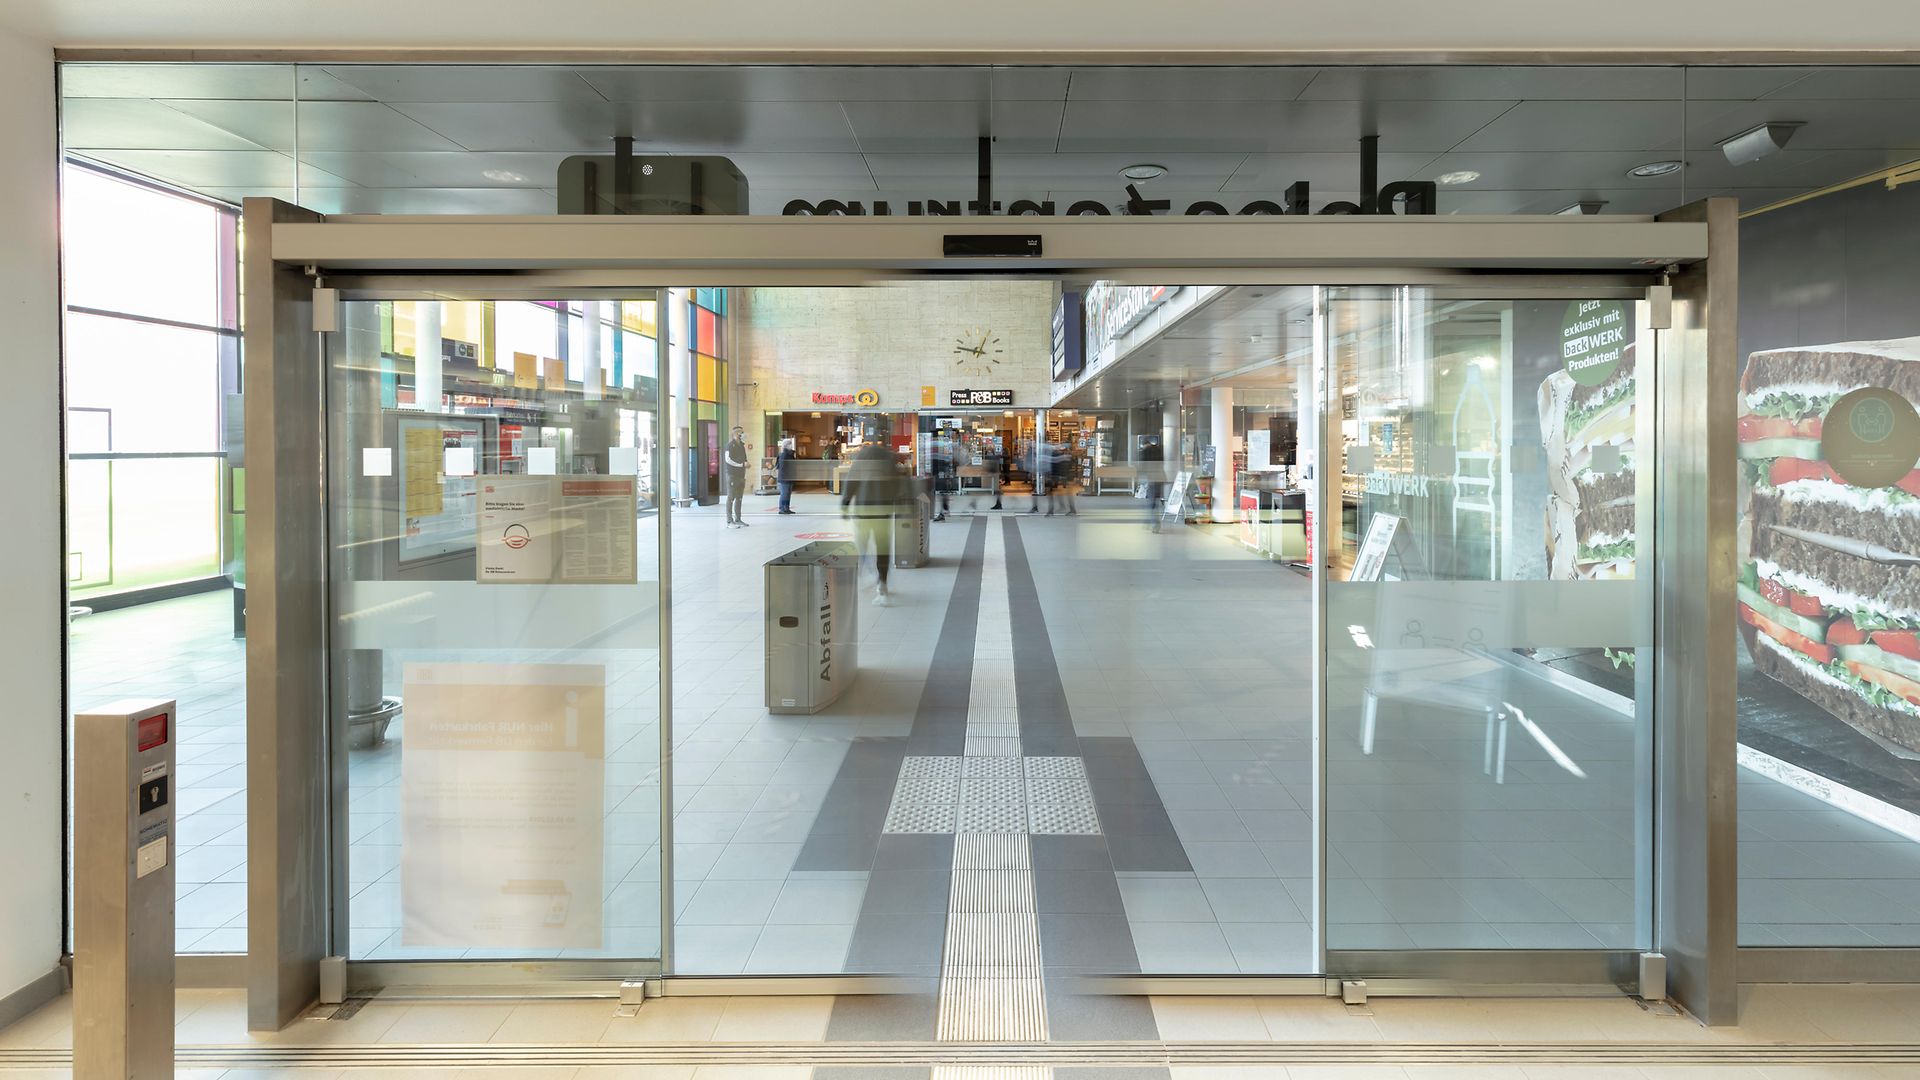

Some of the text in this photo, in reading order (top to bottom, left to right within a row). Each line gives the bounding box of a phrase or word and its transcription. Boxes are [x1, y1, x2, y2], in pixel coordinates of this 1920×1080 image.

[1578, 300, 1601, 317] Jetzt
[1564, 309, 1620, 337] exklusiv mit
[1568, 348, 1619, 371] Produkten!
[812, 392, 854, 405] Kamps
[952, 391, 967, 399] Press
[970, 391, 992, 404] R&B
[820, 604, 831, 681] Abfall
